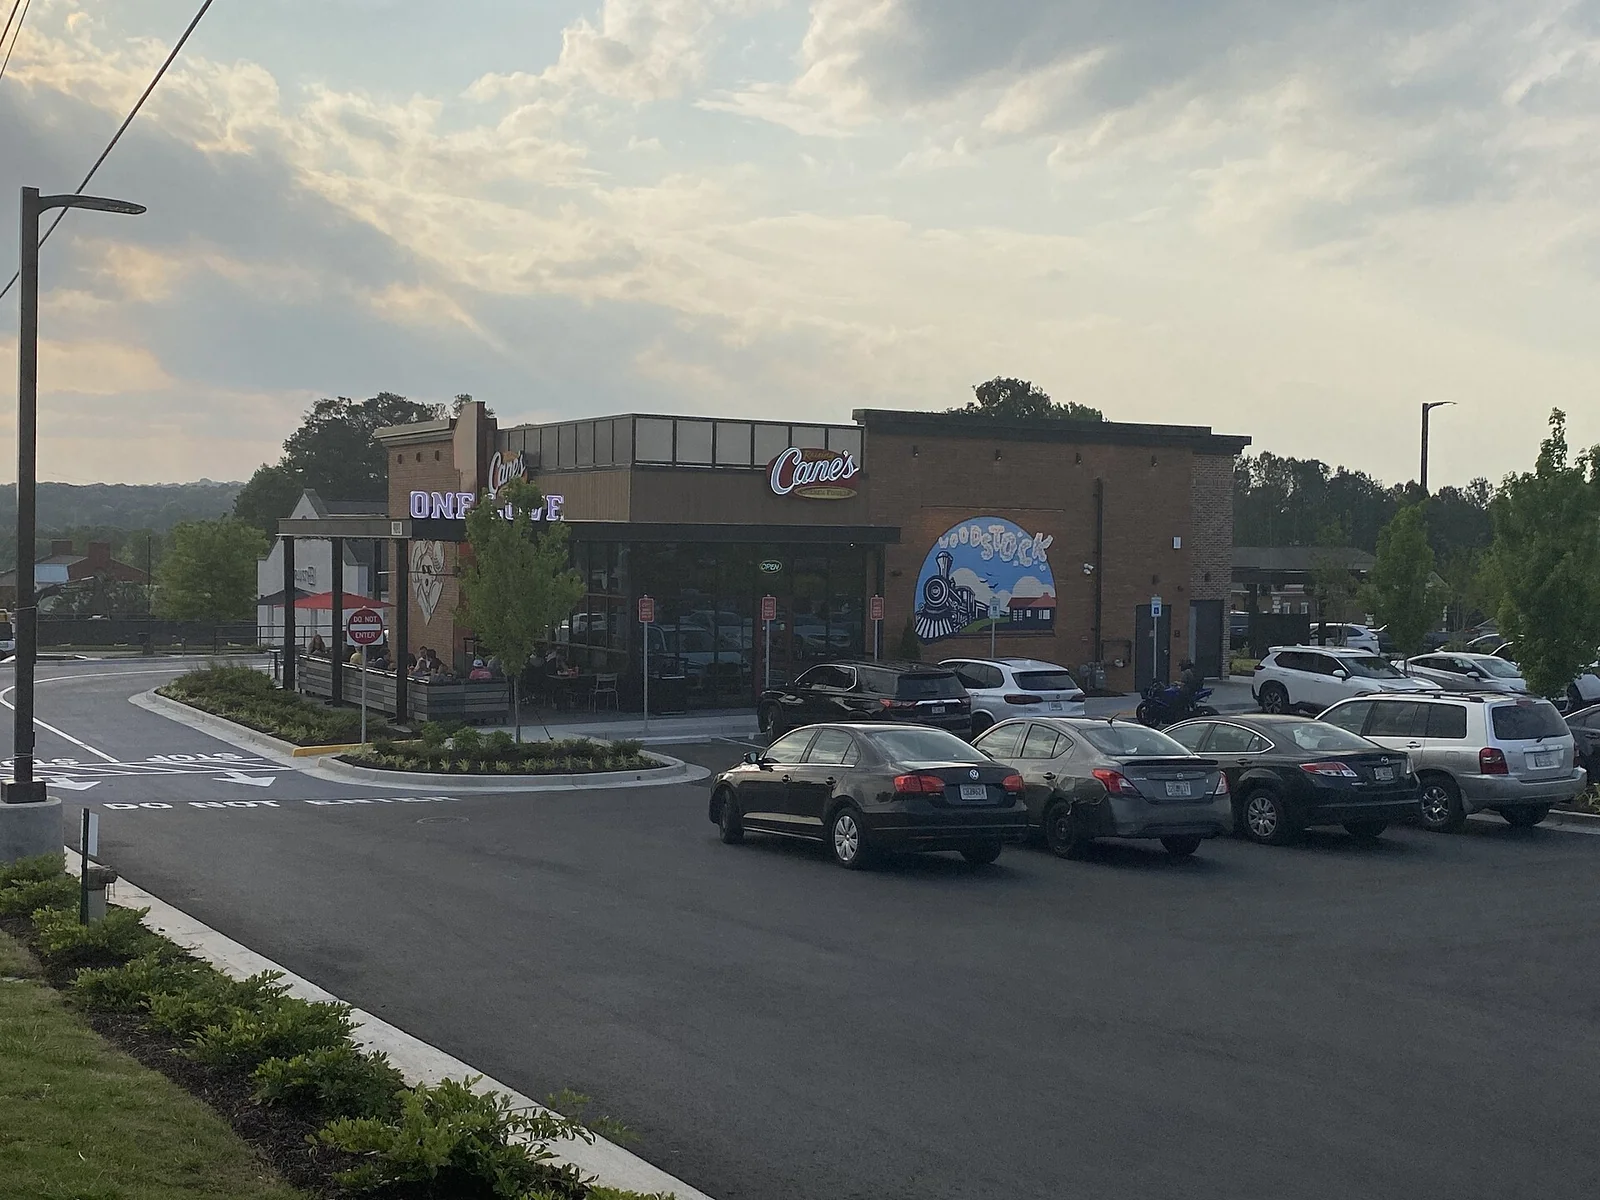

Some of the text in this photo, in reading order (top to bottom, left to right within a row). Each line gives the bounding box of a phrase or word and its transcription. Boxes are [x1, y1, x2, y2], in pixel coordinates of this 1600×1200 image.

[771, 446, 860, 496] Cane's
[410, 490, 476, 520] ONE
[938, 524, 1054, 567] WOODSTOCK
[103, 802, 174, 810] DO
[188, 800, 281, 809] NOT
